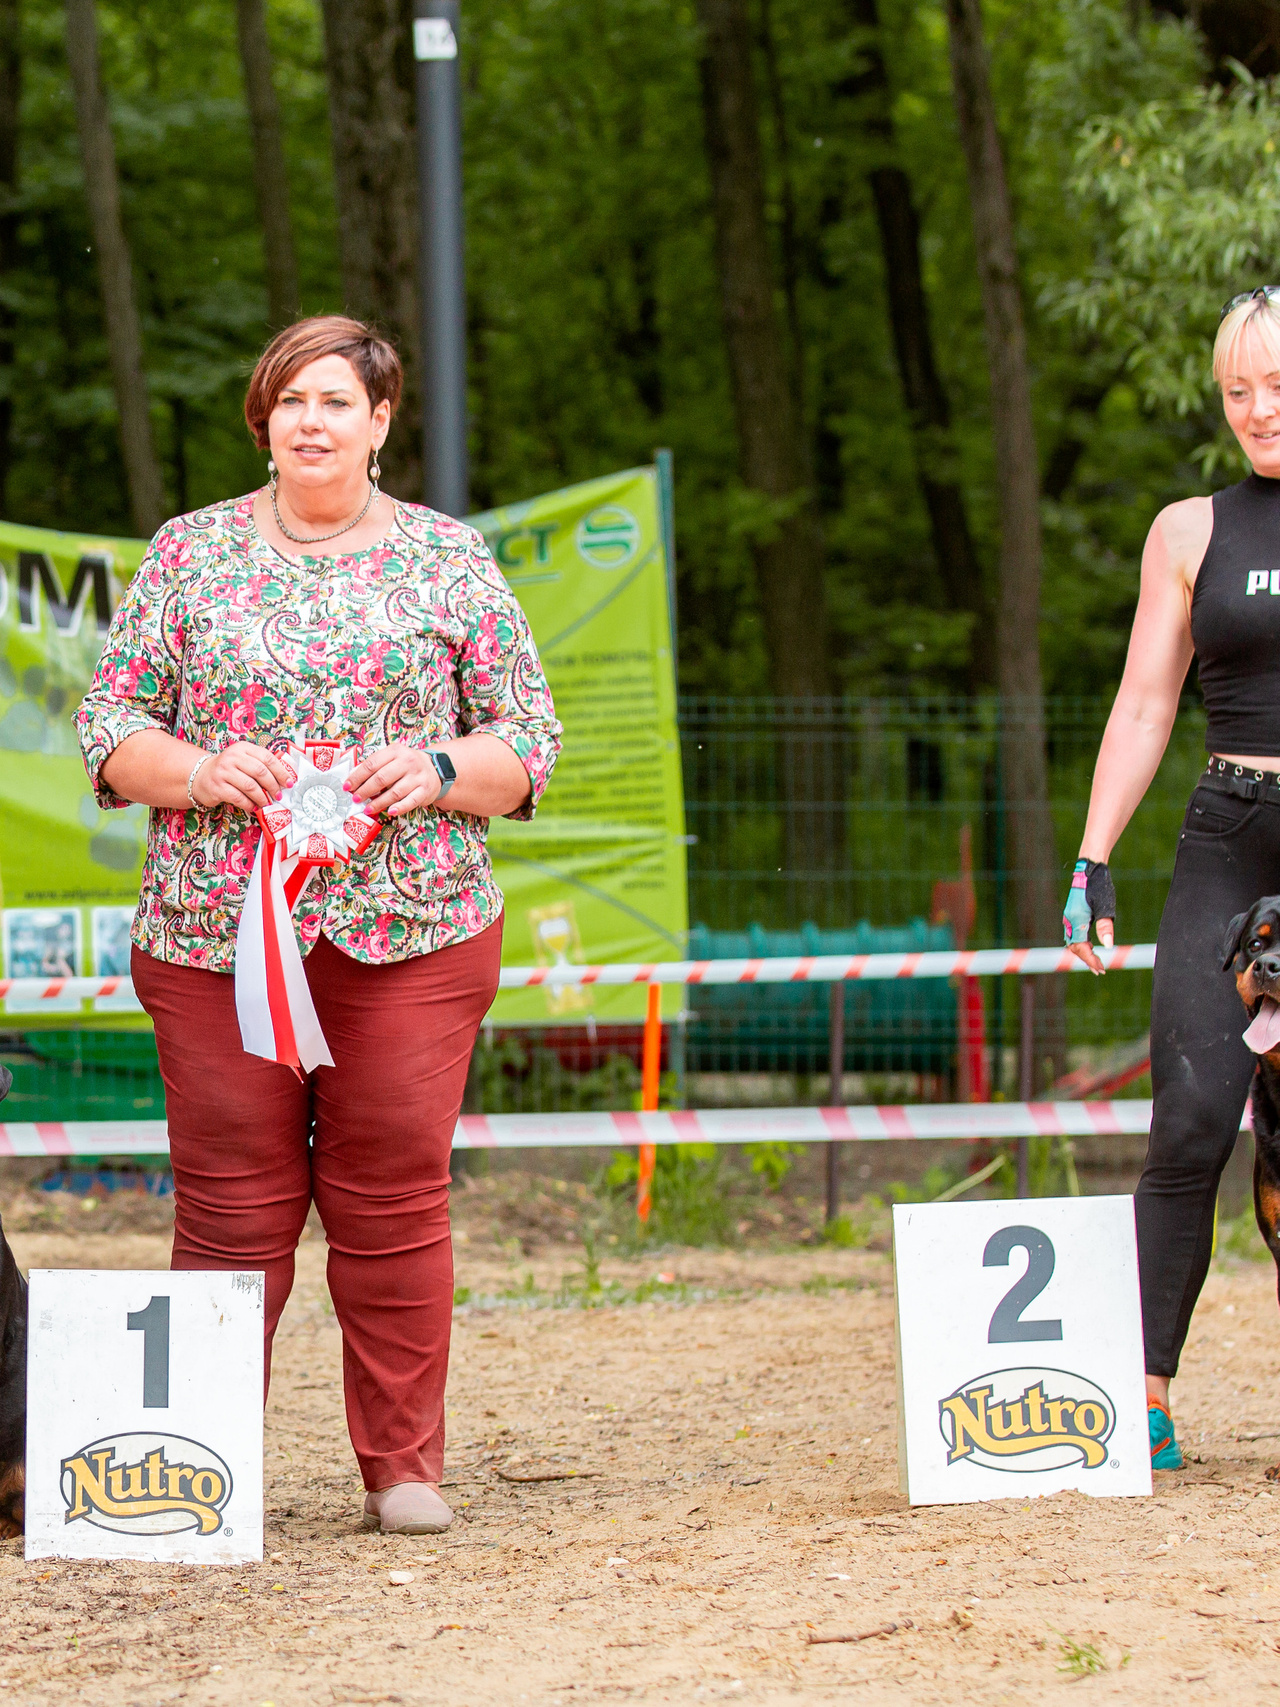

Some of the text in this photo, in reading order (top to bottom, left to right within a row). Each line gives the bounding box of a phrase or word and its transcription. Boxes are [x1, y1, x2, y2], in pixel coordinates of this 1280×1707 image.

[982, 1225, 1064, 1344] 2
[126, 1296, 171, 1408] 1
[938, 1379, 1110, 1469] Nutro
[60, 1445, 225, 1536] Nutro
